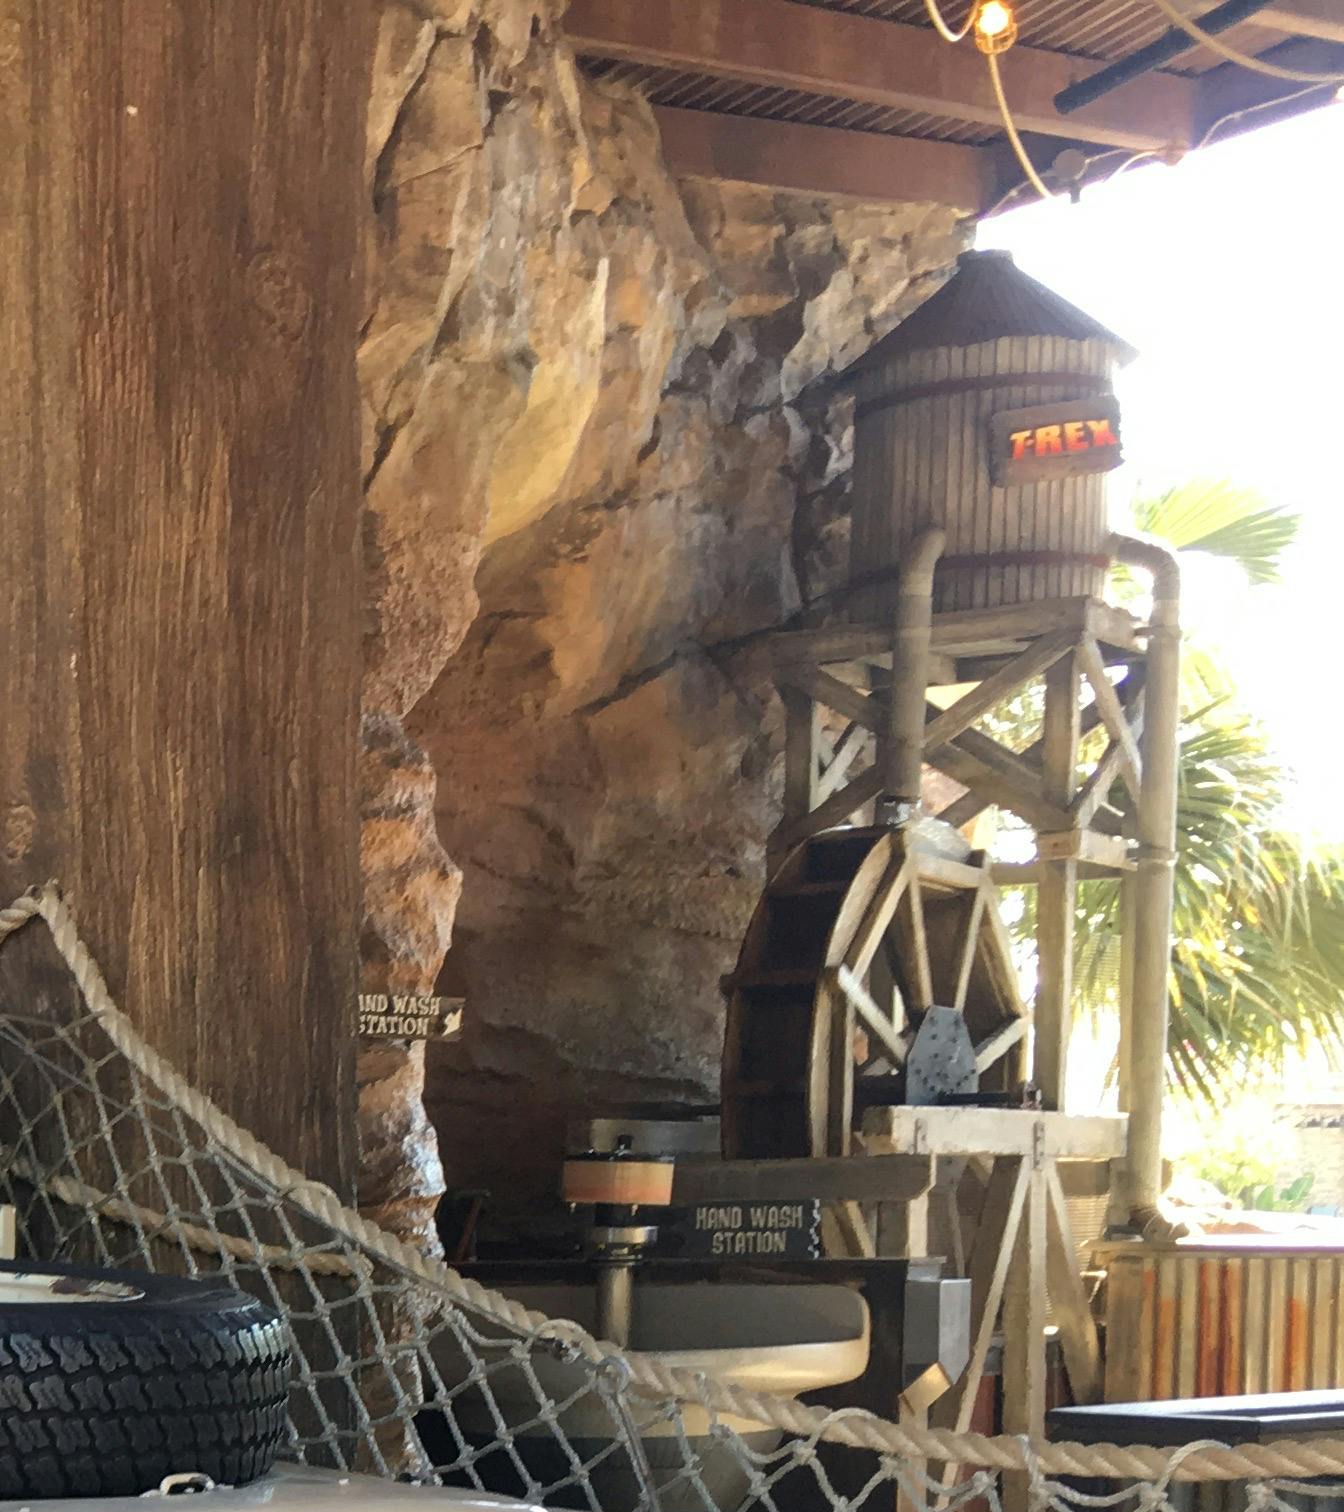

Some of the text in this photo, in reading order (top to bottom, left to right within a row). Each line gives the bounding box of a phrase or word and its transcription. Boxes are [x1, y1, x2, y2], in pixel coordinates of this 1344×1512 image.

[1010, 418, 1117, 461] T-REX
[392, 994, 443, 1016] WASH
[696, 1204, 804, 1230] HAND WASH
[711, 1230, 787, 1255] STATION
